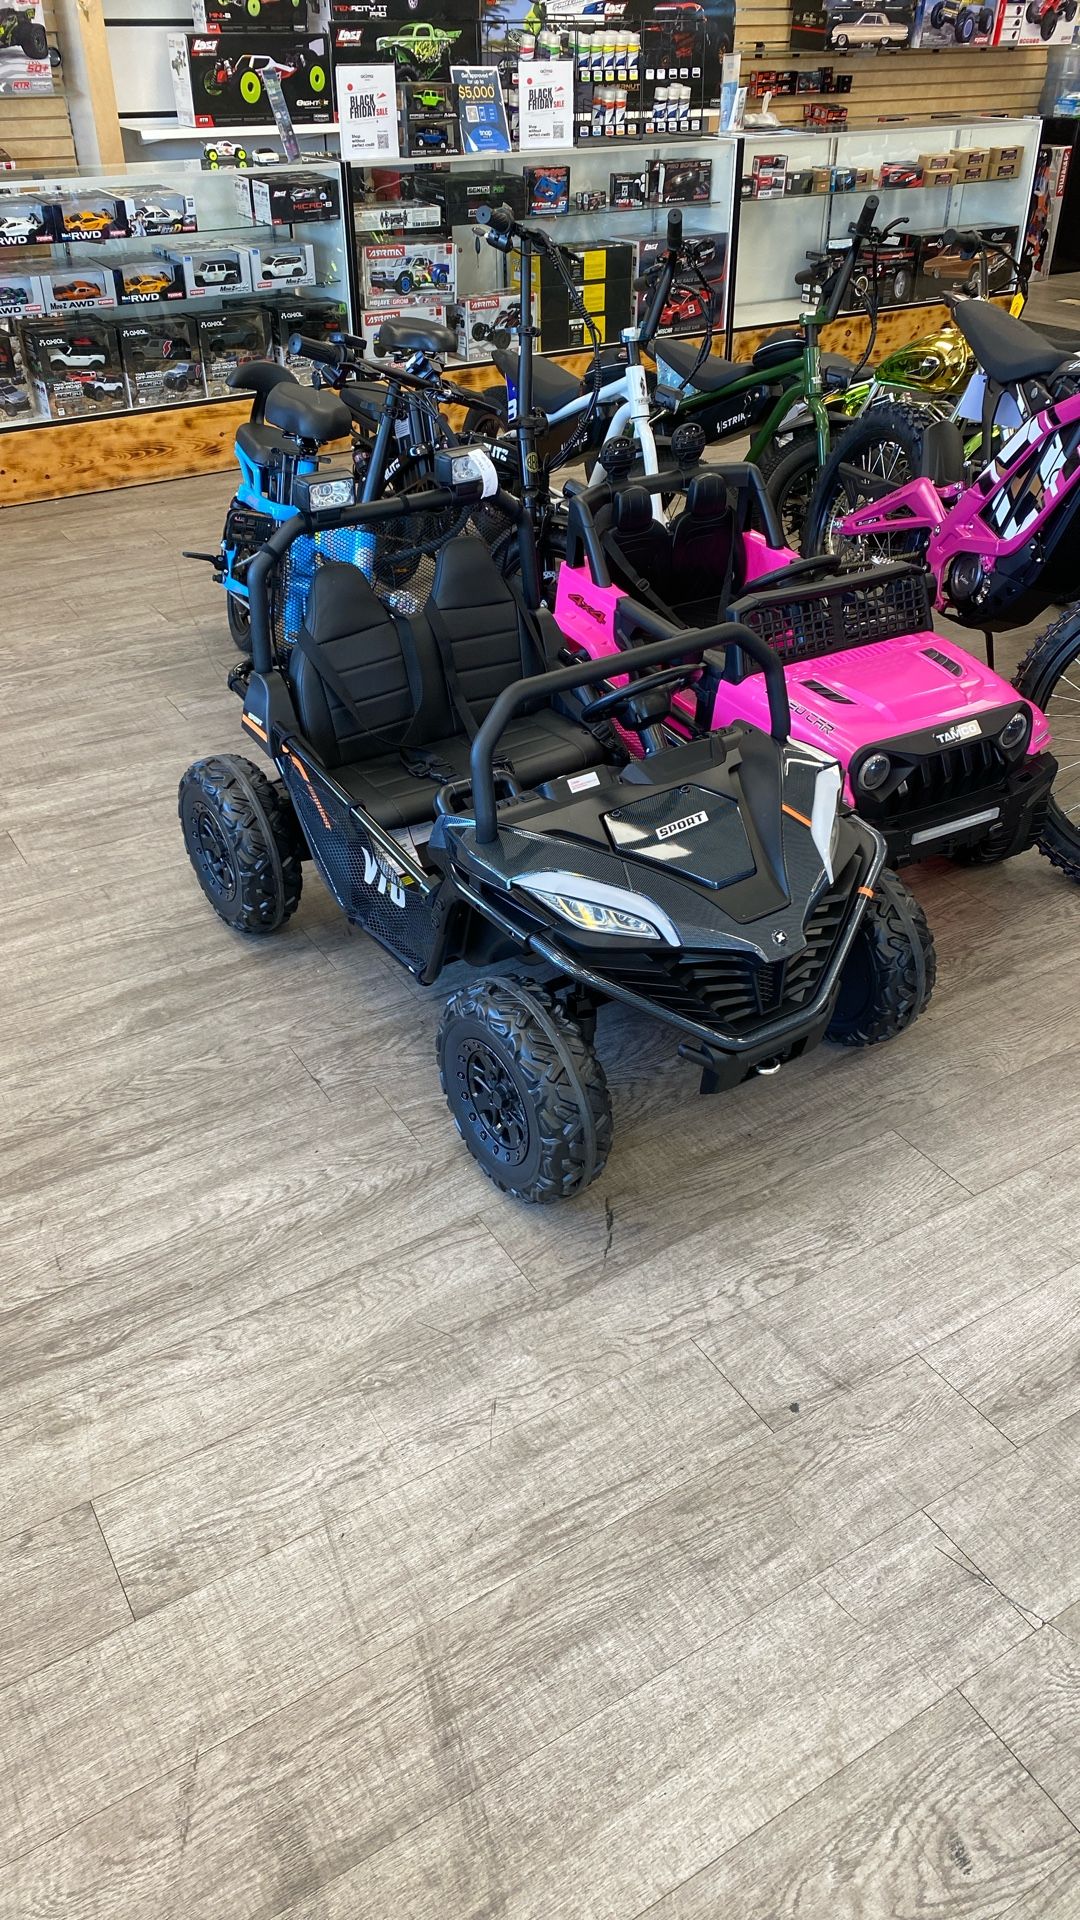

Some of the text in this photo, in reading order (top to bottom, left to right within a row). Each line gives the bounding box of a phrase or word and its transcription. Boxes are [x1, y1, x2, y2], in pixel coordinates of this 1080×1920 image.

[459, 85, 495, 100] $5,000
[529, 88, 553, 101] BLACK
[350, 94, 375, 107] BLACK
[528, 98, 554, 111] FRIDAY
[554, 100, 564, 108] SALE
[350, 105, 376, 119] FRIDAY
[376, 108, 388, 116] SALE
[71, 231, 101, 240] RWD
[131, 294, 160, 302] RWD
[69, 301, 95, 310] AWD
[936, 724, 977, 743] TAMCO
[659, 813, 704, 837] SPORT
